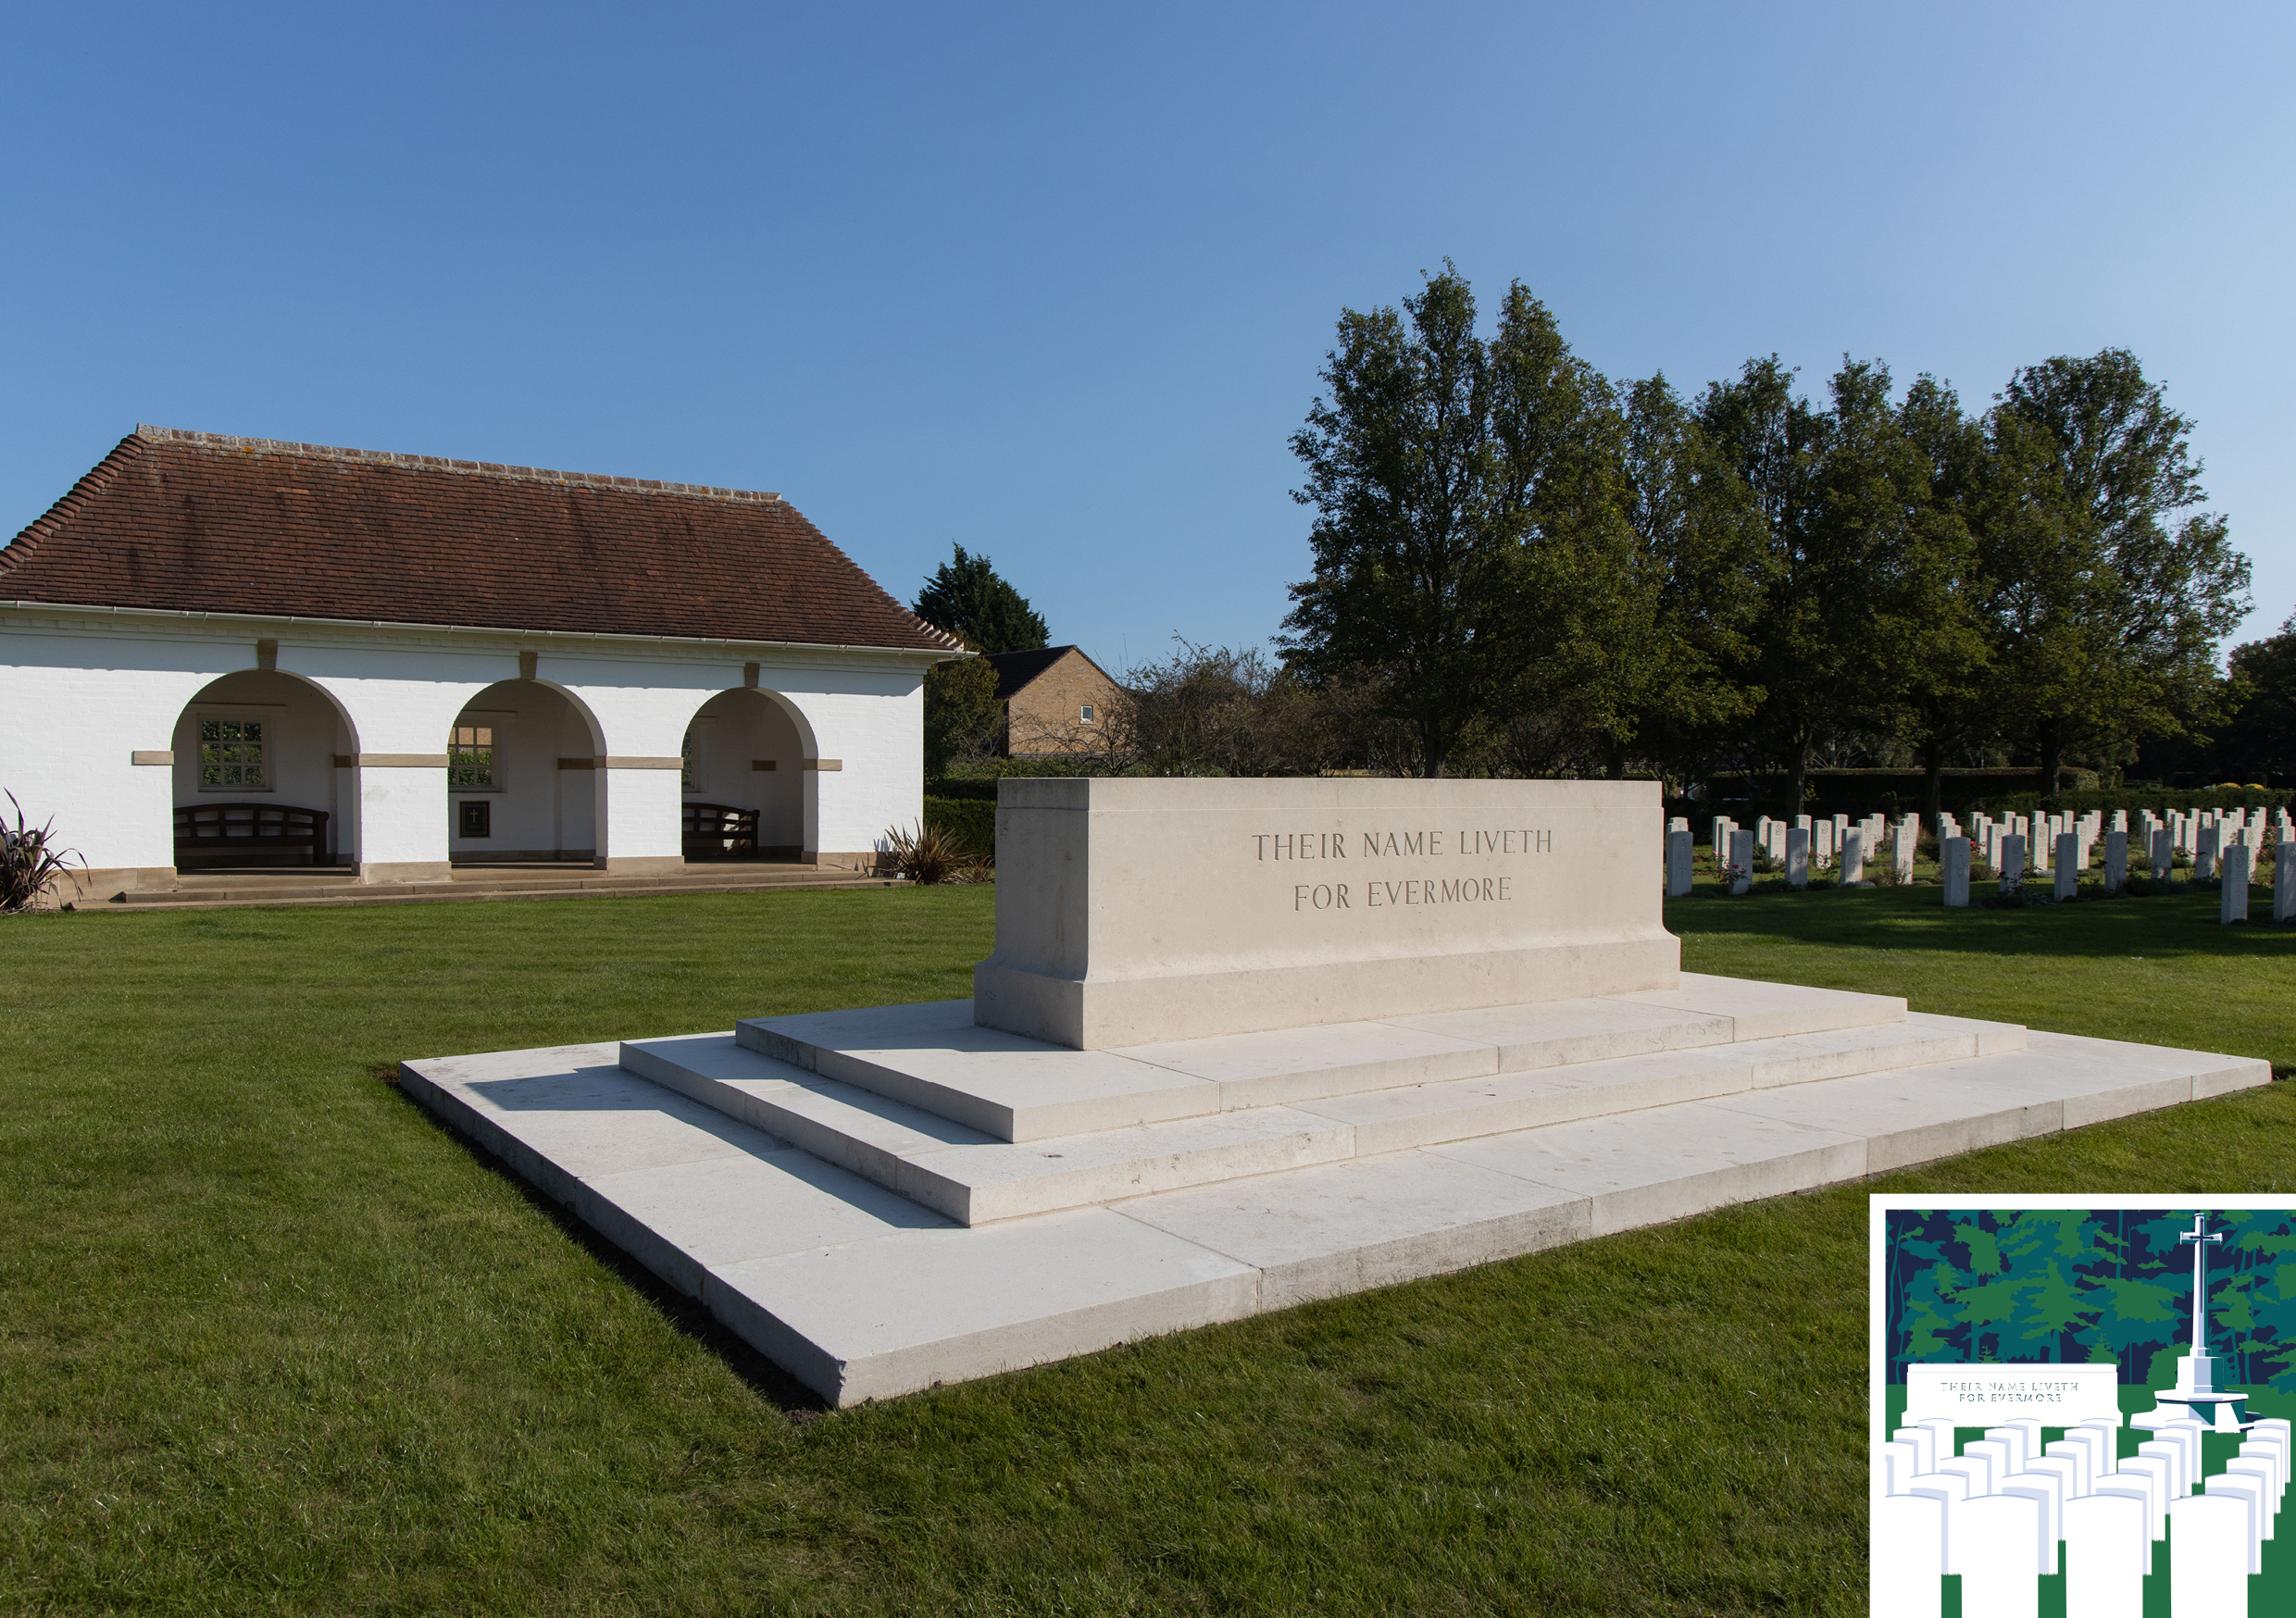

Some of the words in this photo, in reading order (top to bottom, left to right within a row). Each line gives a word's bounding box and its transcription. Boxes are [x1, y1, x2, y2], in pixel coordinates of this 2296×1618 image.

[1252, 832, 1347, 861] THEIR
[1364, 830, 1443, 857] NAME
[1460, 829, 1552, 855] LIVETH
[1294, 883, 1351, 911] FOR
[1367, 877, 1512, 907] EVERMORE
